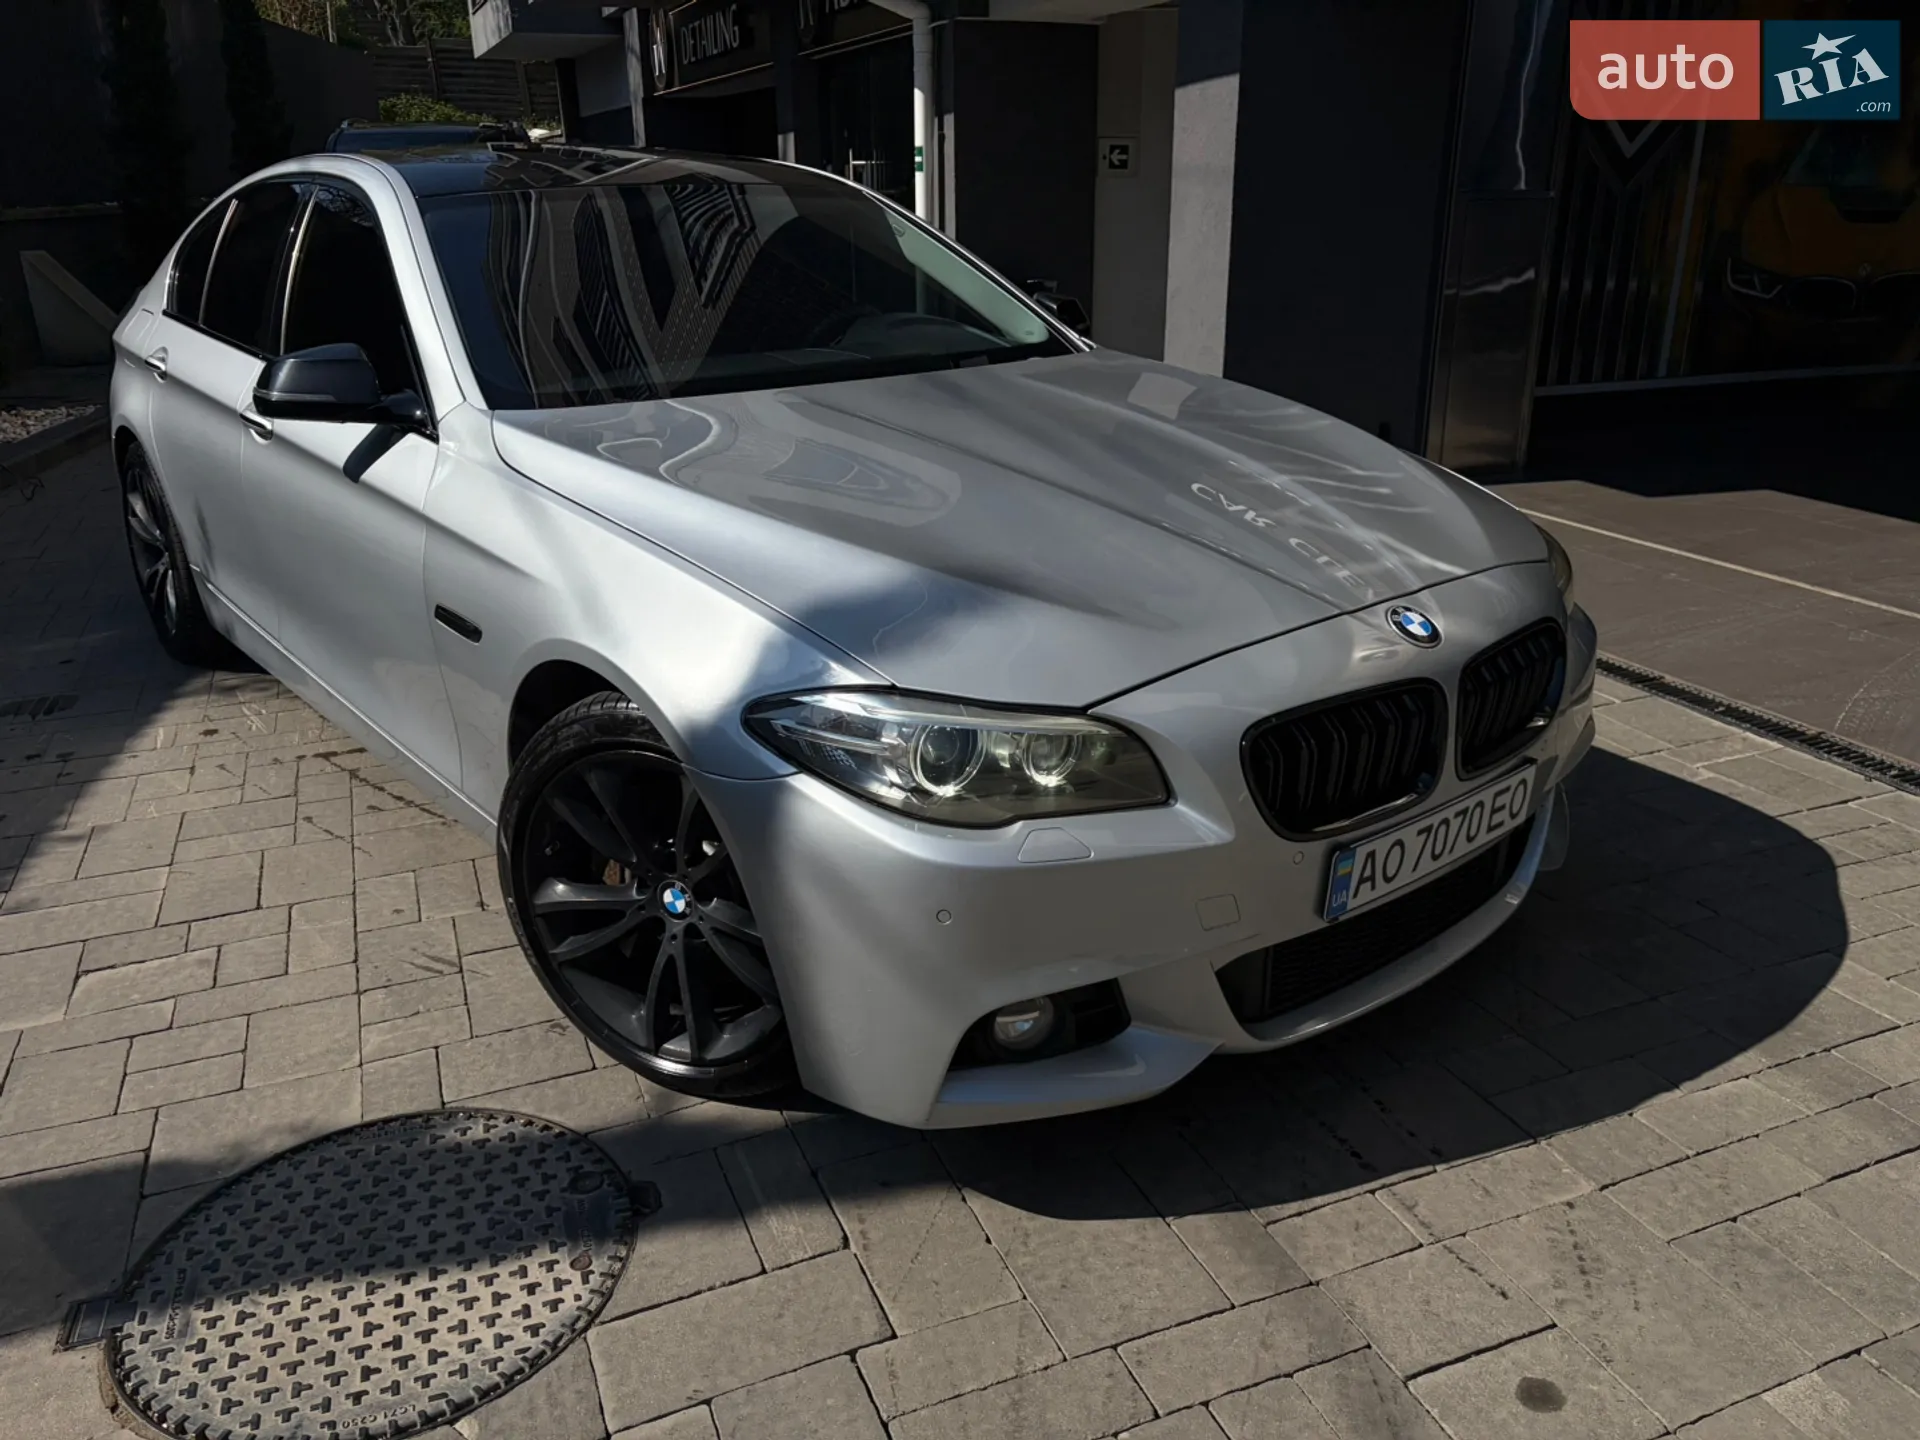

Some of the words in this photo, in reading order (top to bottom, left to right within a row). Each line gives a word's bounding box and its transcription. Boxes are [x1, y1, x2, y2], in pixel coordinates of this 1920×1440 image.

[680, 3, 740, 65] DETAILING
[1353, 838, 1405, 899] AO
[1412, 800, 1484, 873] 7070
[1487, 778, 1528, 834] EO
[1331, 892, 1347, 908] UA
